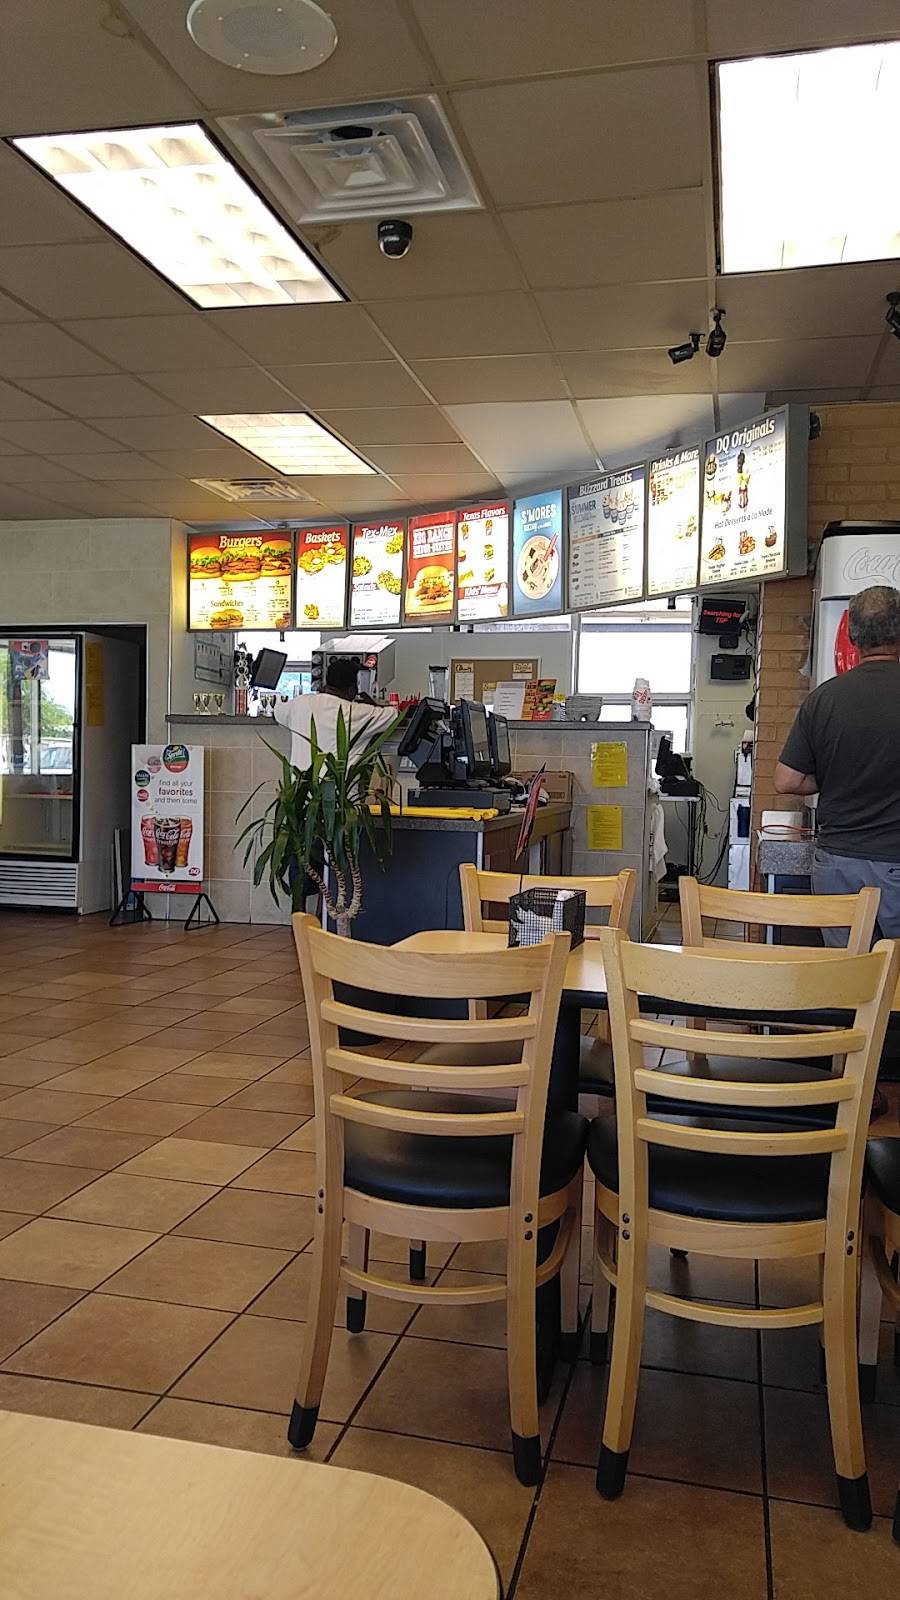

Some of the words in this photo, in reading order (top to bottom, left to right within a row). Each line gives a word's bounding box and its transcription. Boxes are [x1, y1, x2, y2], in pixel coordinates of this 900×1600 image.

[716, 435, 729, 454] DQ
[732, 419, 775, 447] Originals
[652, 458, 673, 473] Drinks
[674, 456, 680, 466] &
[680, 449, 699, 463] More
[579, 480, 608, 496] Blizzard
[610, 473, 632, 487] Treats
[462, 510, 480, 522] Texas
[481, 507, 506, 519] Flavors
[521, 504, 556, 524] S'MORES
[571, 500, 597, 515] SUMMER
[305, 532, 341, 544] Baskets
[362, 524, 398, 539] Tex-Mex
[218, 536, 262, 551] Burgers
[210, 600, 244, 608] Sandwiches
[703, 609, 732, 618] Searching
[180, 780, 192, 788] your
[158, 788, 193, 796] favorites
